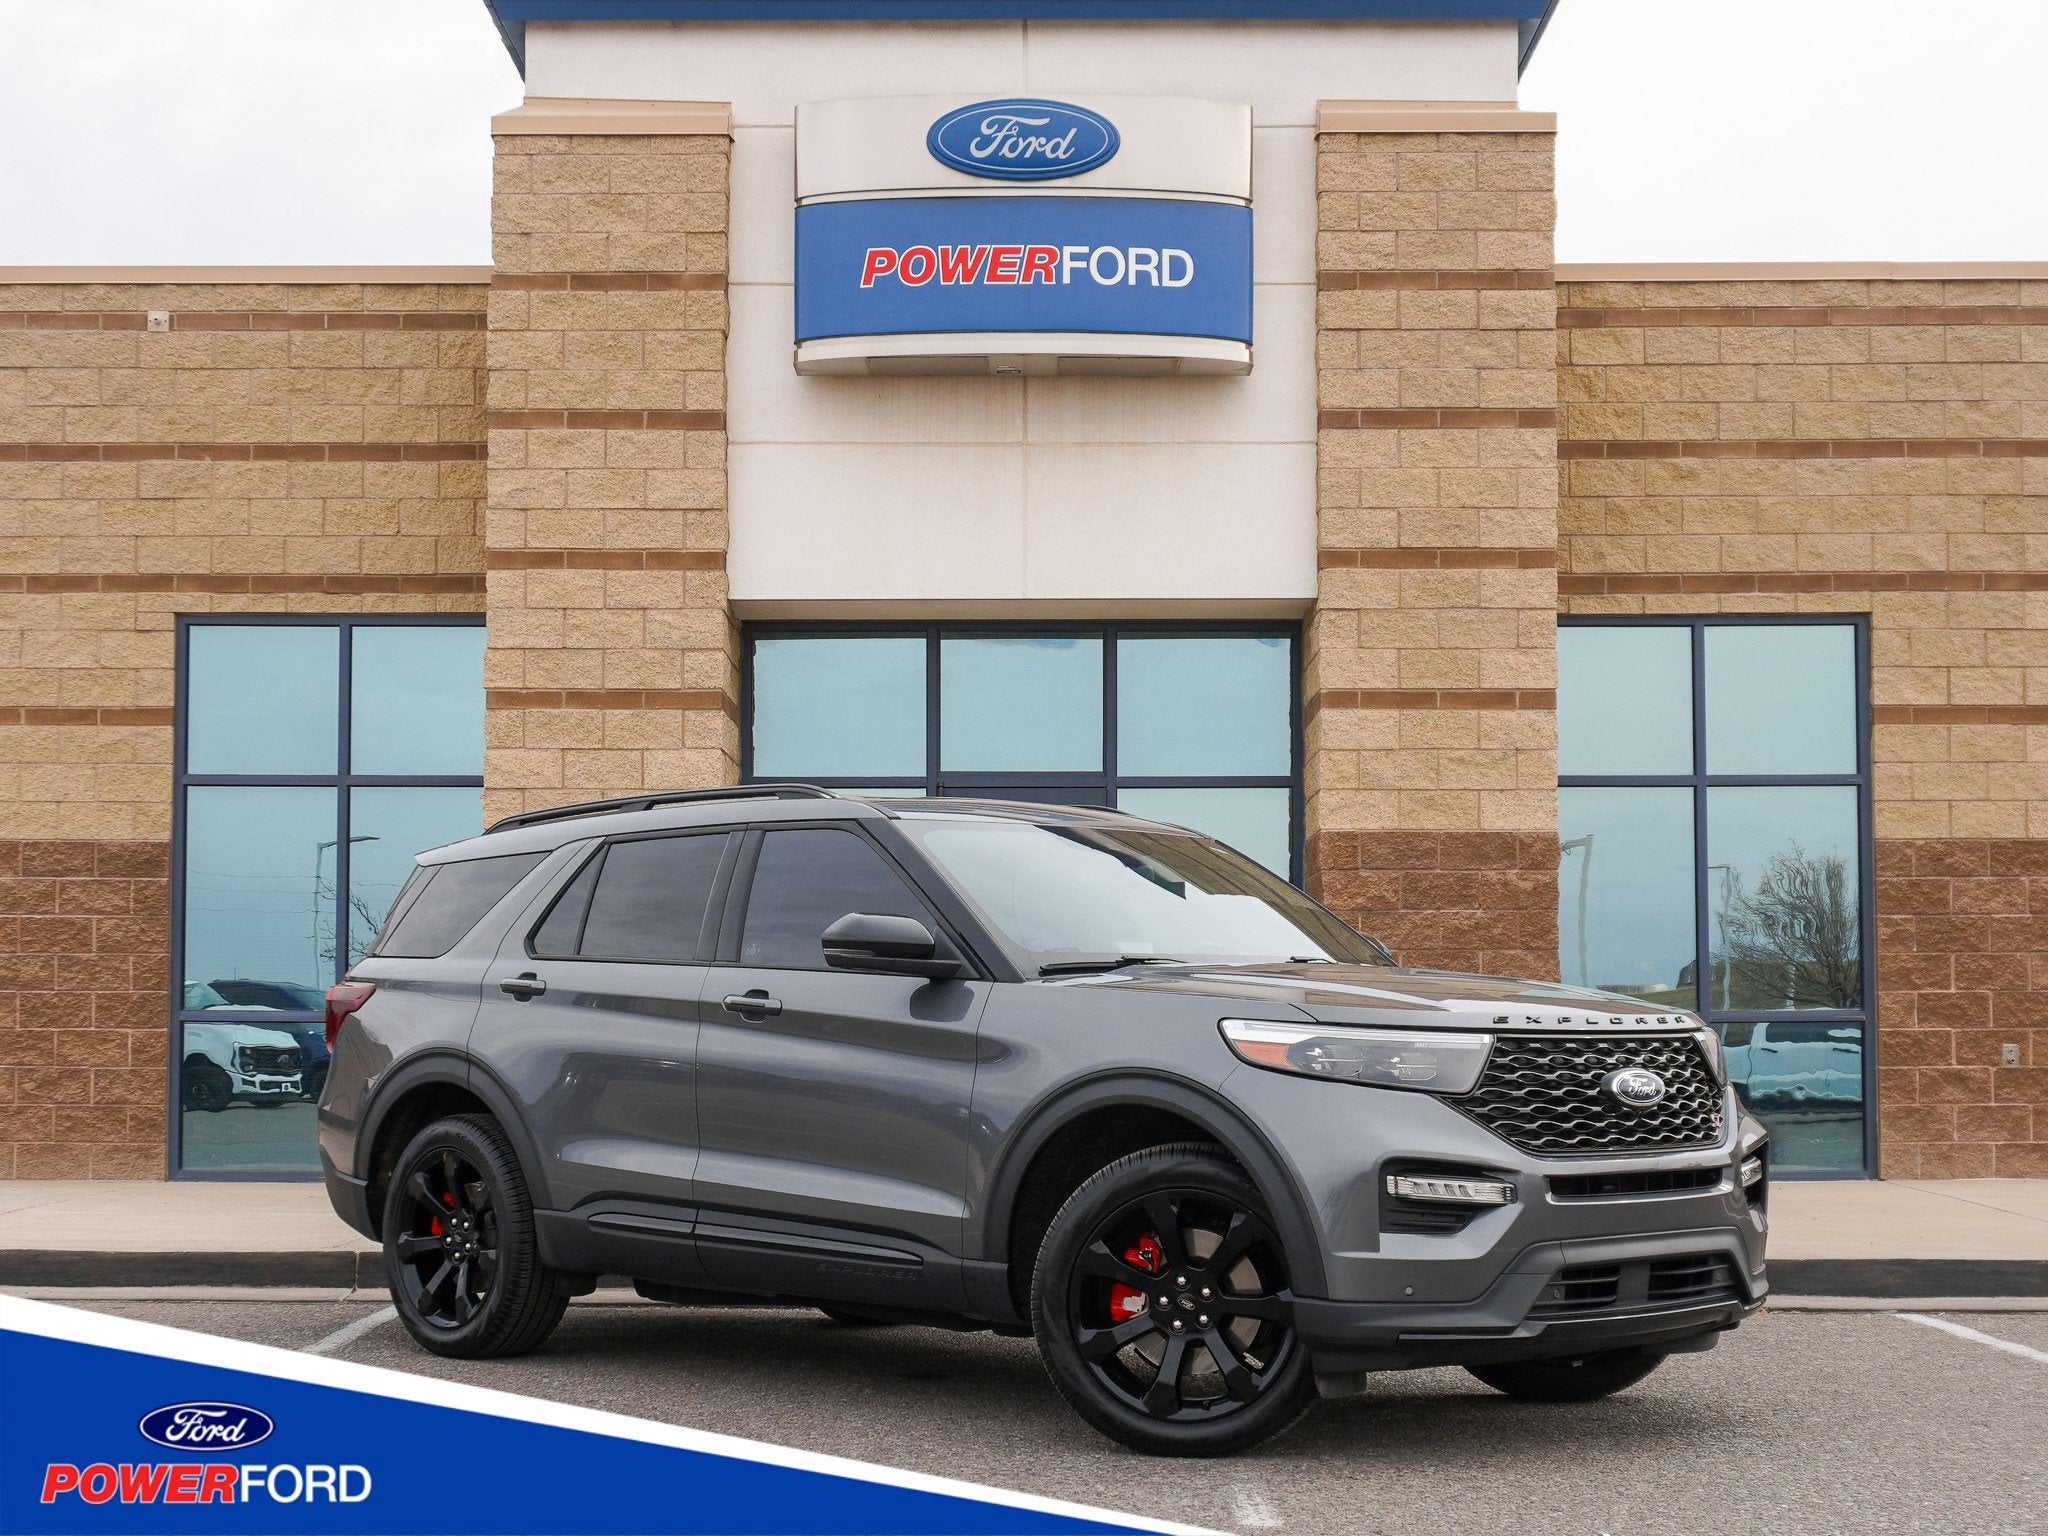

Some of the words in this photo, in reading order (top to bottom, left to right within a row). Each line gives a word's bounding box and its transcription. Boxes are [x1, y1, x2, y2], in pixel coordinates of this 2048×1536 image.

[970, 114, 1077, 160] Ford
[1492, 1015, 1686, 1025] EXPLORER
[1628, 1077, 1657, 1096] Ford
